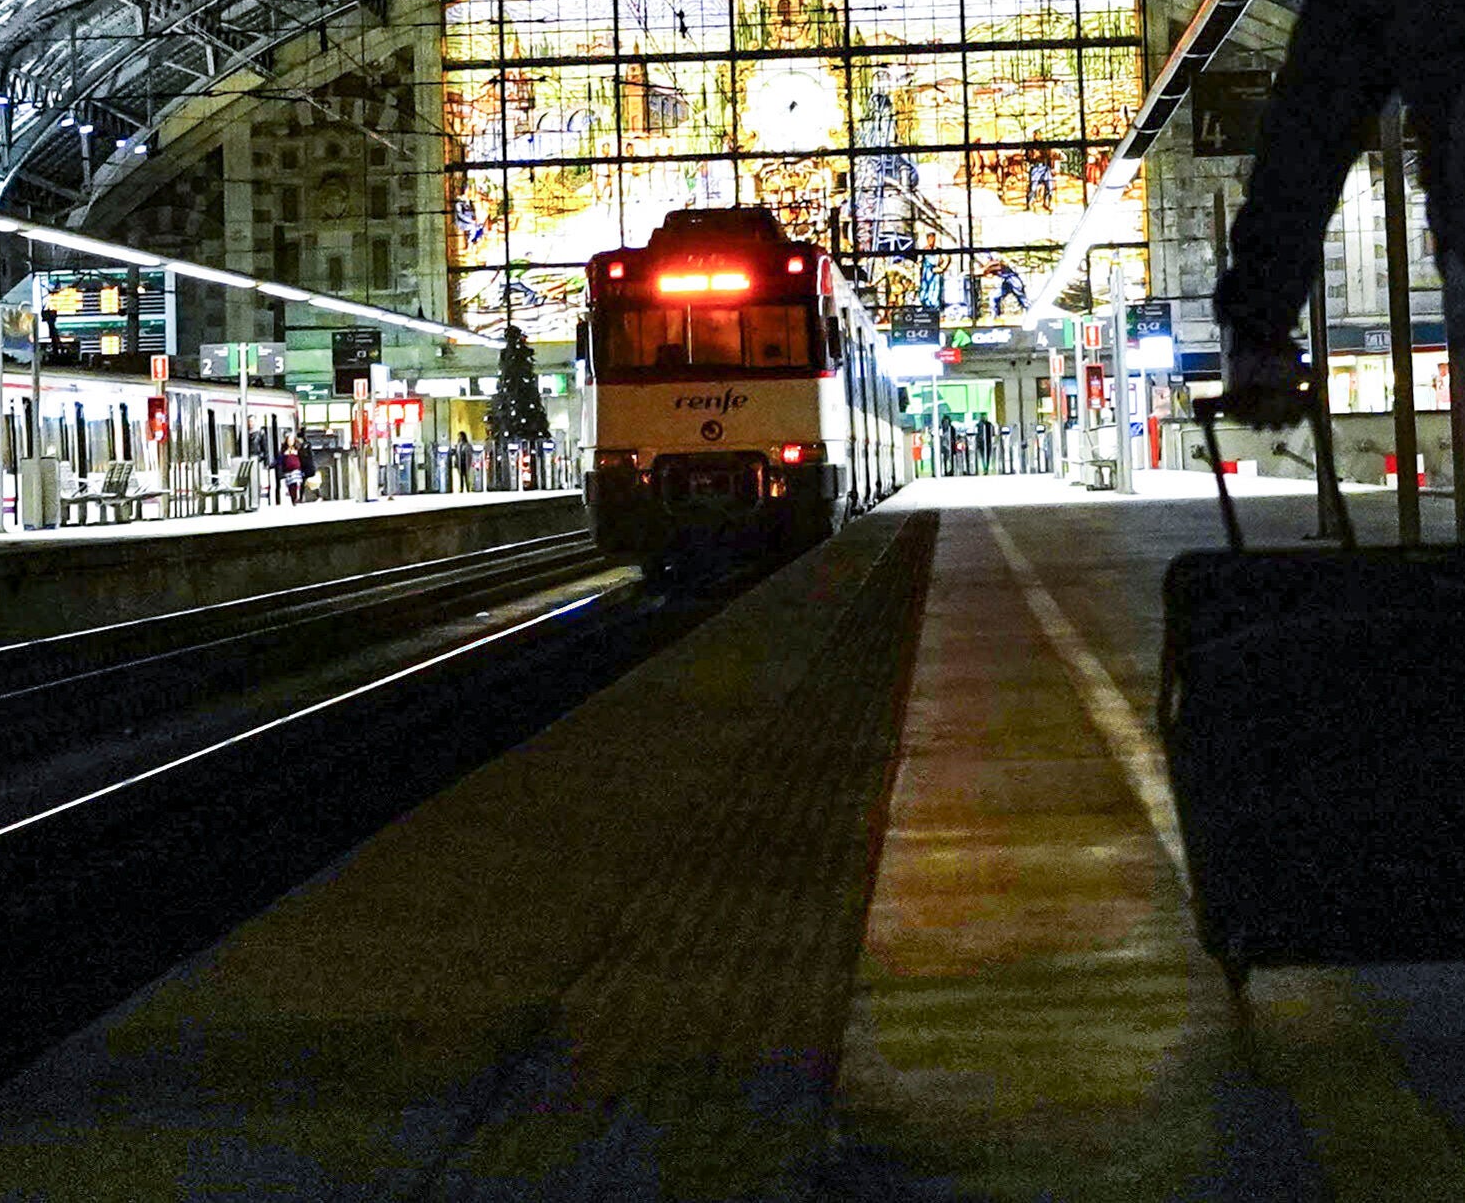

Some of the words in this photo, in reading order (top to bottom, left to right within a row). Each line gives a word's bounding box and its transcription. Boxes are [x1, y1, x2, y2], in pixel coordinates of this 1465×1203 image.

[1201, 112, 1227, 149] 4
[202, 359, 213, 375] 2
[274, 357, 284, 373] 3
[673, 388, 749, 415] renfe
